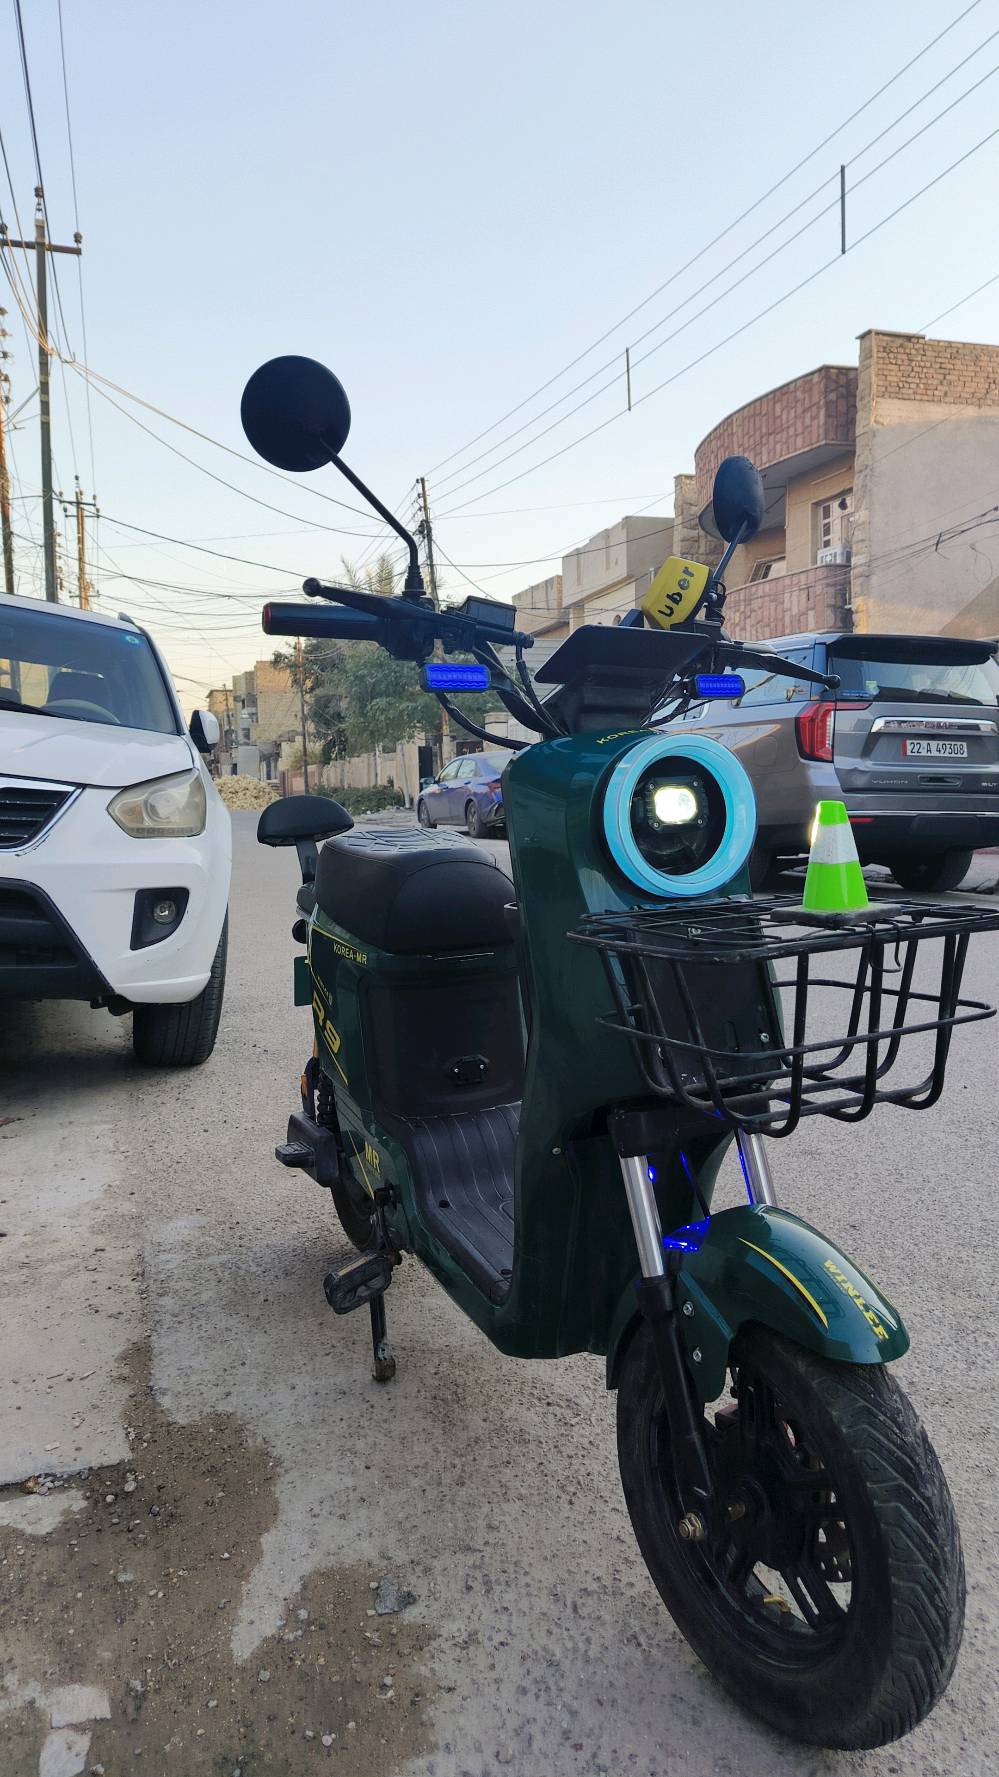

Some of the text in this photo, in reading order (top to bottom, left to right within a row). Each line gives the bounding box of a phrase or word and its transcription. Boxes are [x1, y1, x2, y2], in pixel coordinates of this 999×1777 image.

[910, 742, 965, 755] 22 A 49308
[333, 942, 367, 965] KOREA-MR
[364, 1140, 380, 1173] MR
[824, 1260, 889, 1340] WINLEE
